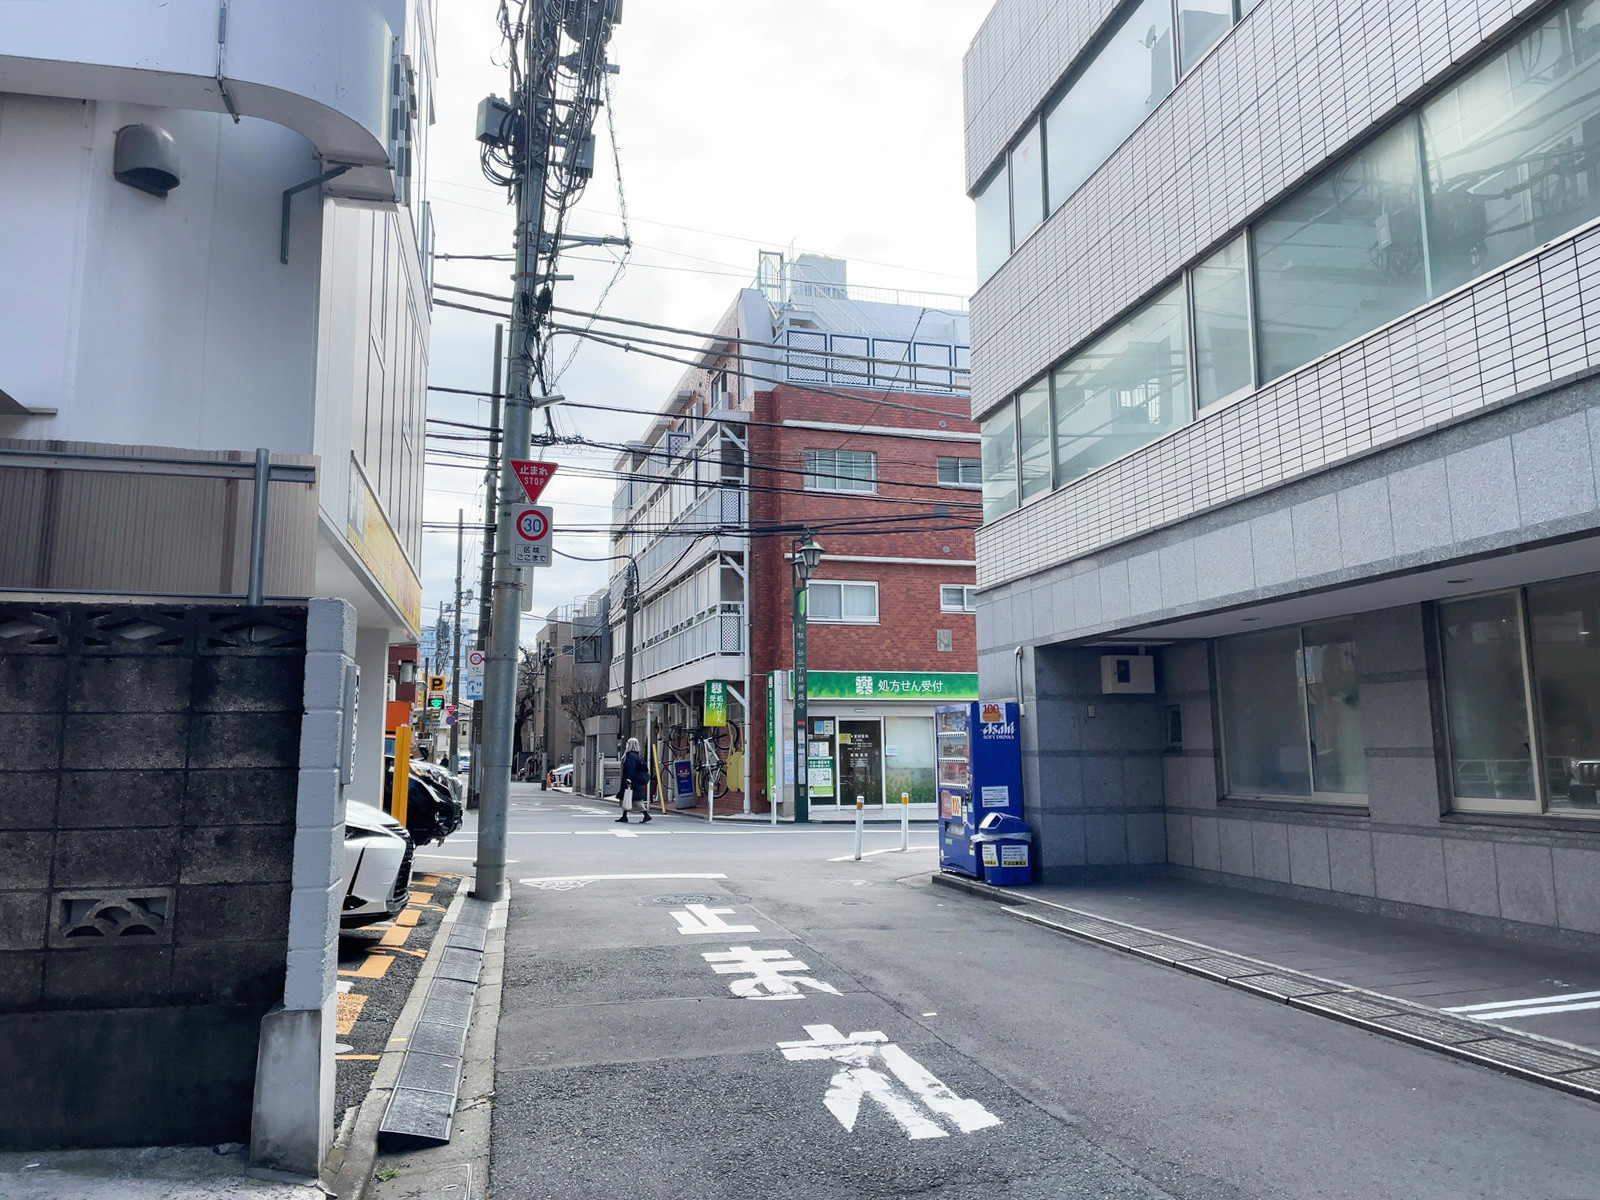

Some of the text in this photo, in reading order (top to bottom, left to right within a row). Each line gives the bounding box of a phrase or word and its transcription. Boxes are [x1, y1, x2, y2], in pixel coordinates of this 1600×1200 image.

[519, 465, 548, 476] 止まれ
[524, 477, 545, 486] STOP
[523, 518, 541, 533] 30
[523, 546, 540, 554] 区域
[516, 553, 546, 562] ここまで
[431, 678, 443, 691] P
[878, 679, 943, 693] 処方せん受付
[709, 694, 717, 710] 受付
[716, 694, 724, 724] 処方せん
[982, 720, 1015, 735] Asahi
